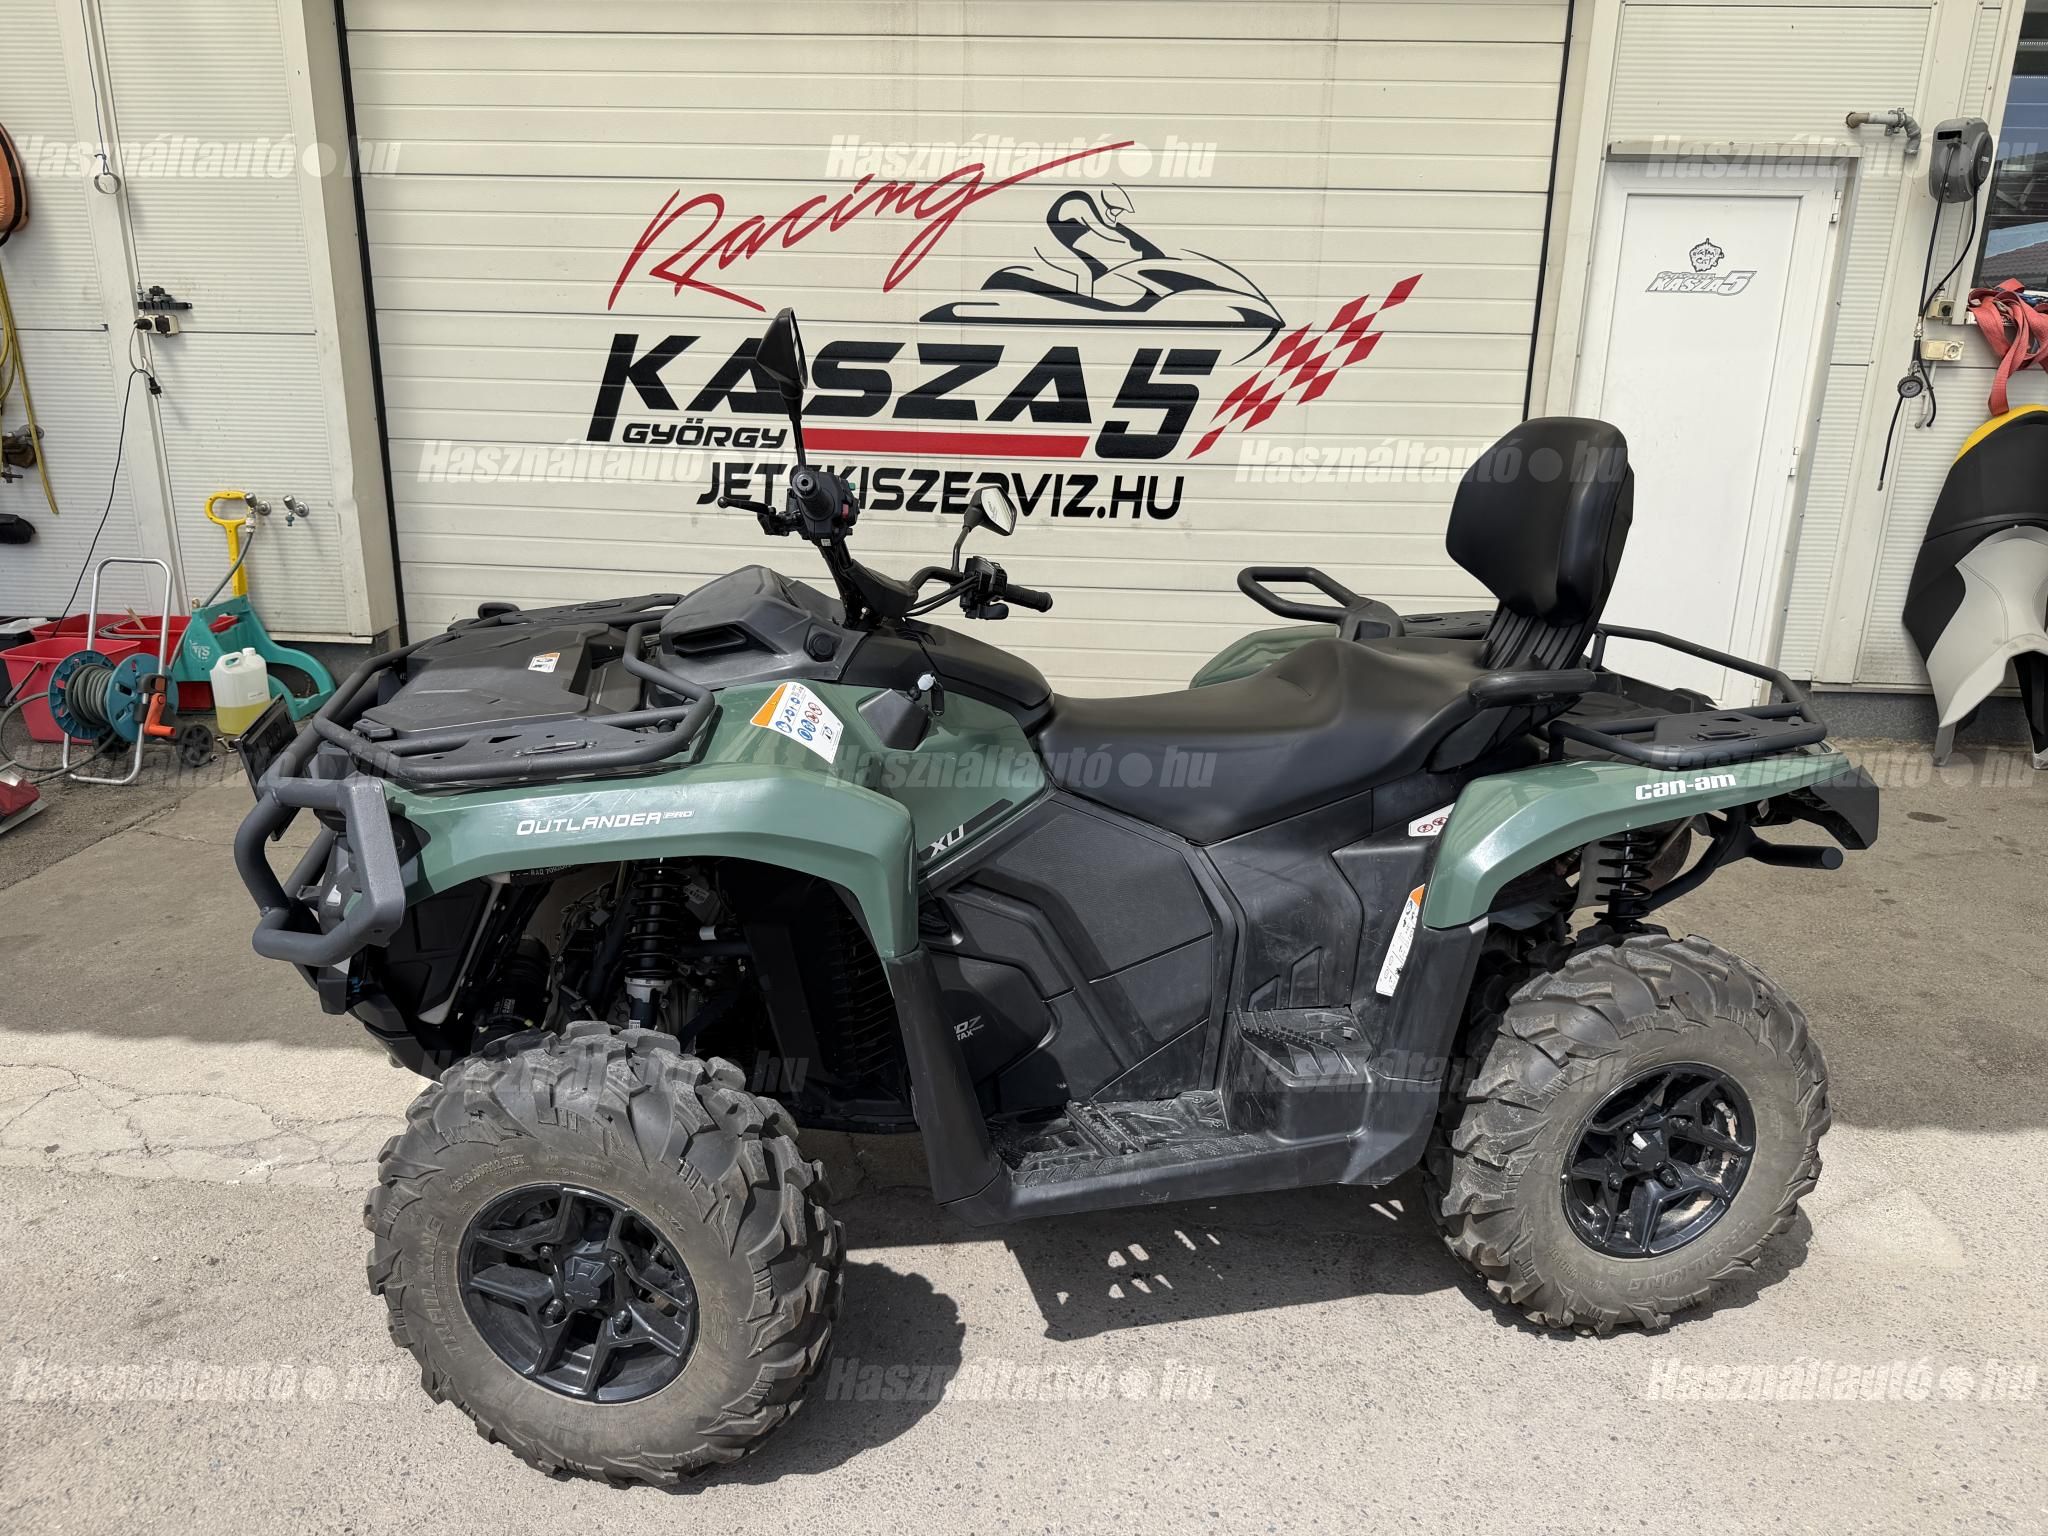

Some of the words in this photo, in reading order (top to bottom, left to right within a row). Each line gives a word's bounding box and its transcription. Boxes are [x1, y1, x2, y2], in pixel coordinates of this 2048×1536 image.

[607, 140, 1134, 313] Racing
[622, 418, 788, 449] GYÖRGY
[1635, 774, 1737, 801] can-am
[516, 811, 661, 836] OUTLANDER
[662, 810, 696, 820] PRO
